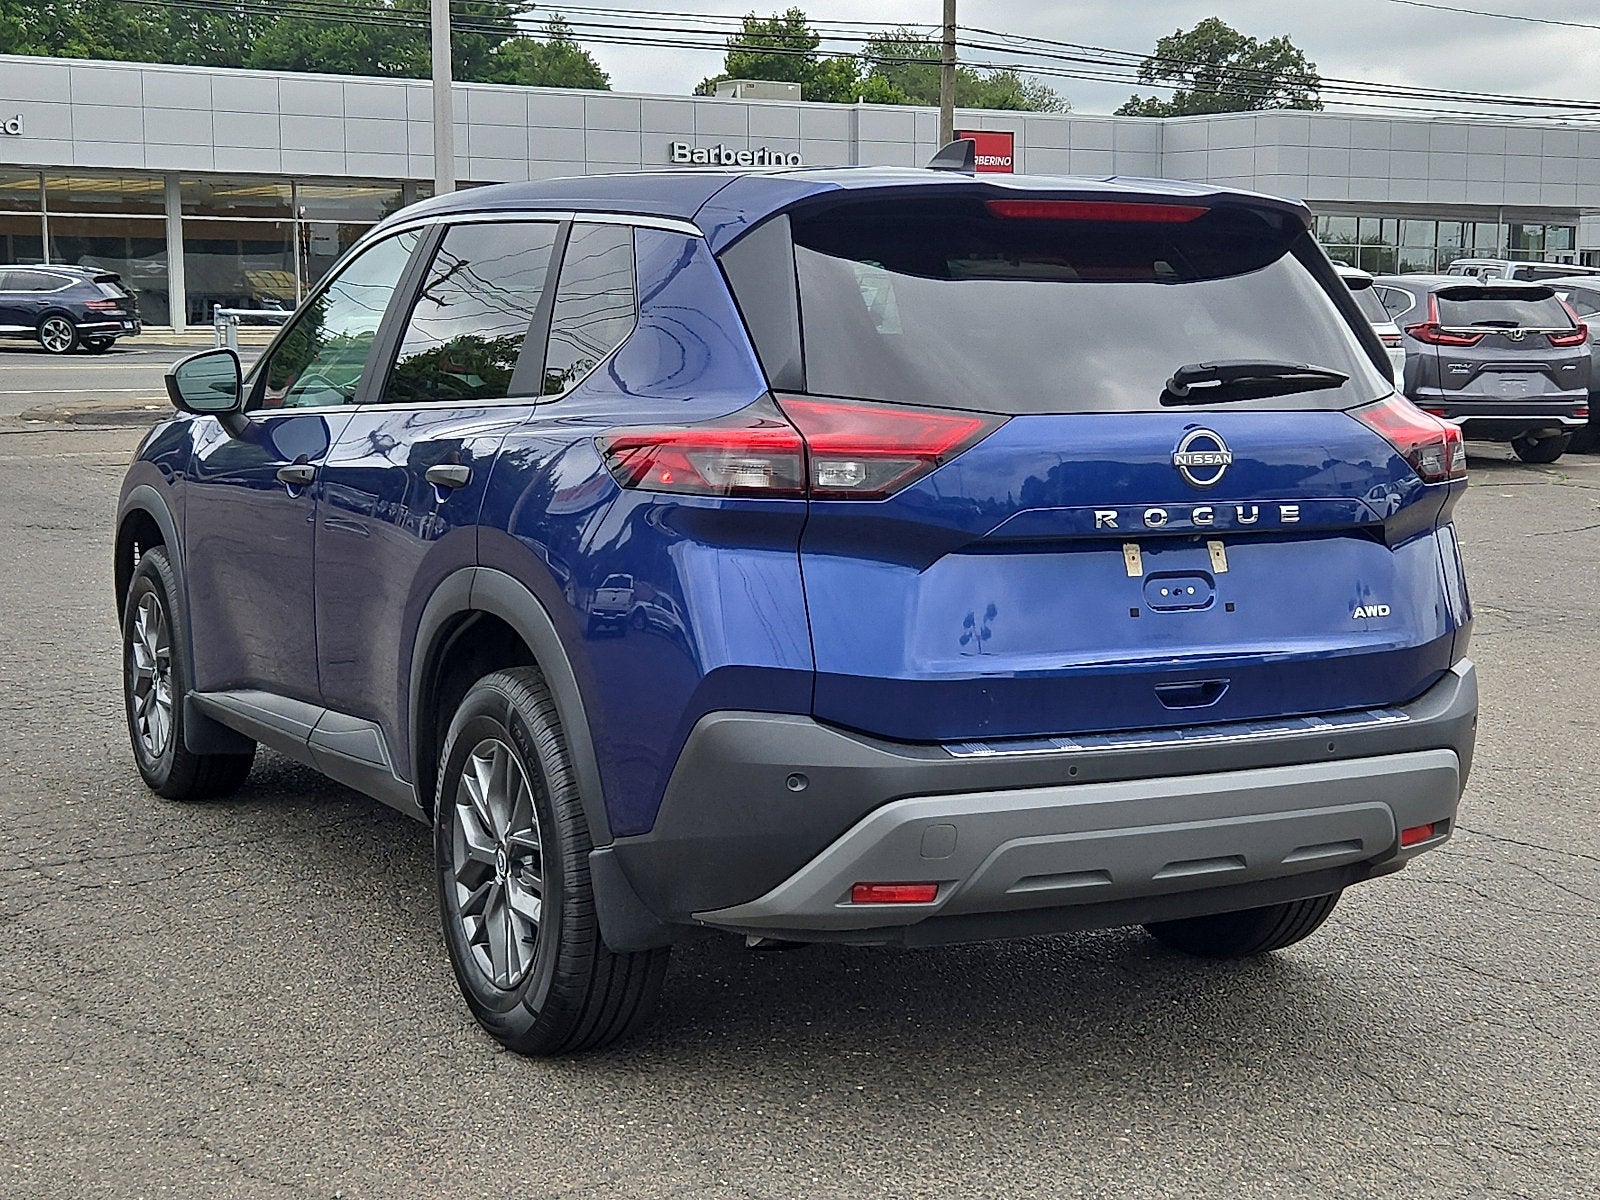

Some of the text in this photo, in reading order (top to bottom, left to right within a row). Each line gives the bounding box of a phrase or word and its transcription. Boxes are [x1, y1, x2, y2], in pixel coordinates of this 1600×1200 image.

[670, 141, 803, 165] Barberino
[974, 155, 1012, 167] RBERINO
[1174, 453, 1232, 466] NISSAN
[1093, 505, 1301, 529] ROGUE
[1352, 604, 1391, 619] AWD
